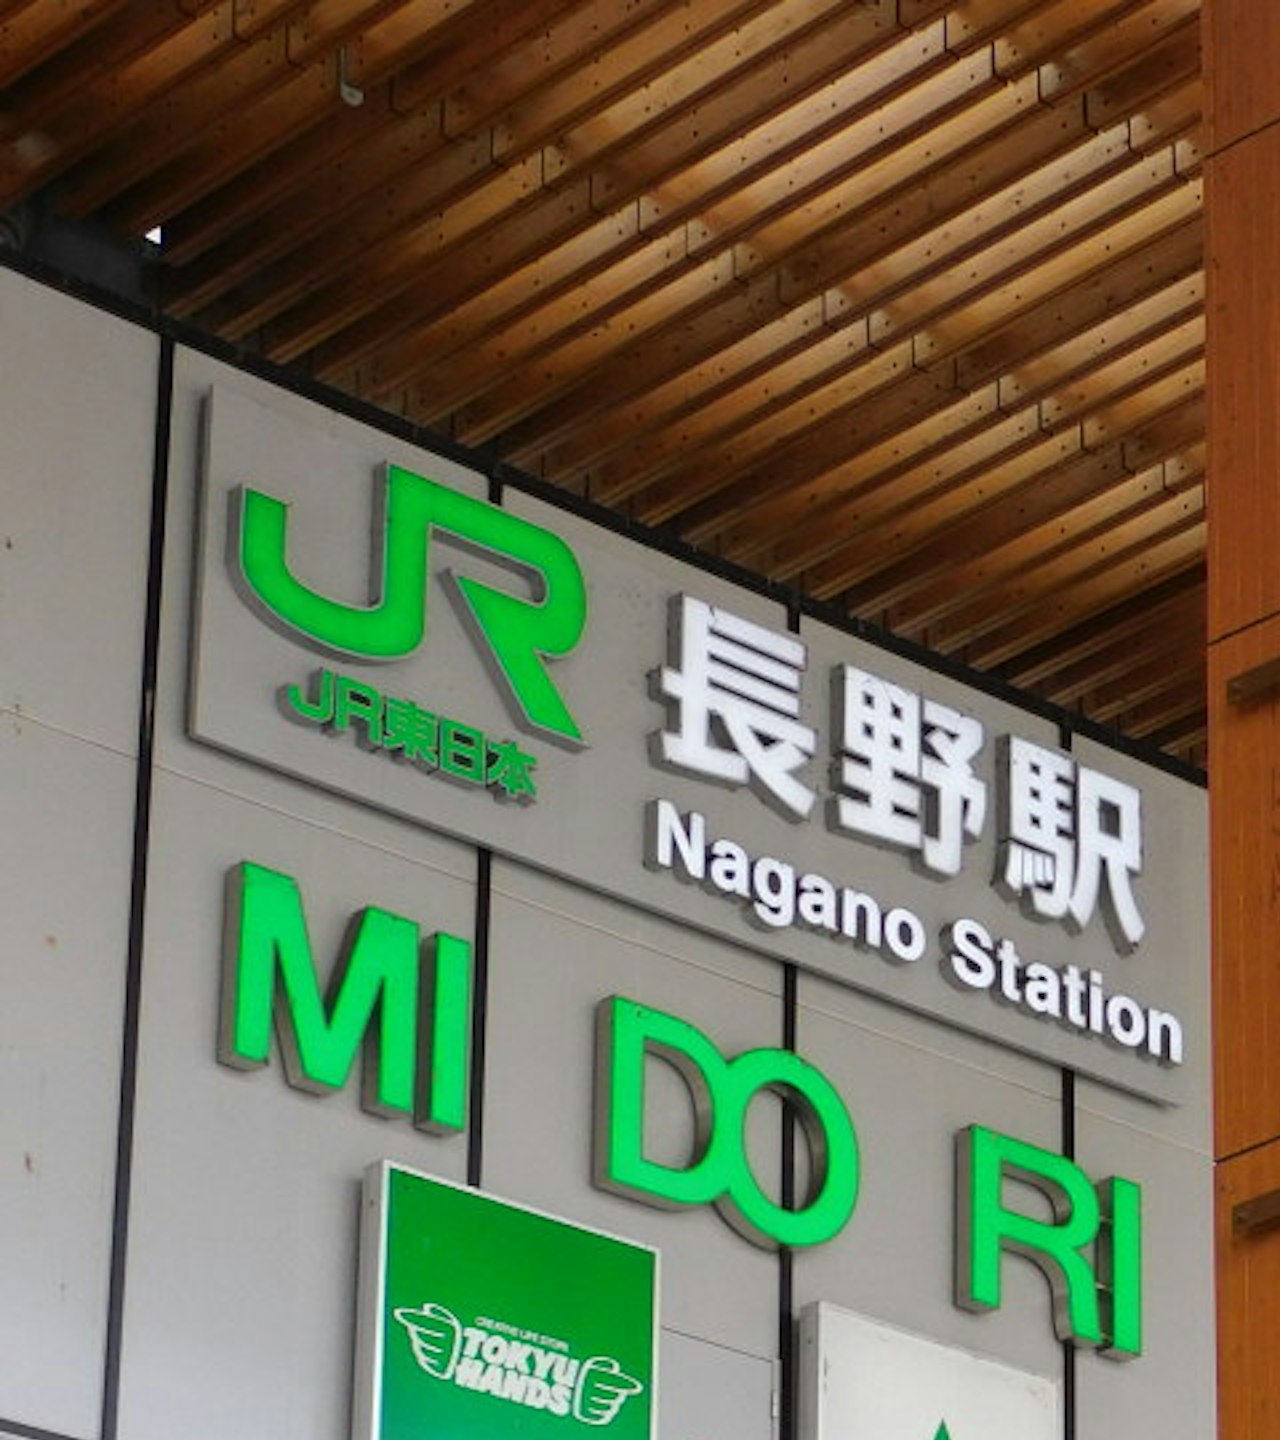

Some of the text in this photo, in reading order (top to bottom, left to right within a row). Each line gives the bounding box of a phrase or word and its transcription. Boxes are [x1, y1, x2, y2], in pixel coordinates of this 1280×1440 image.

[234, 462, 588, 748] JR
[279, 668, 539, 803] JR東日本
[653, 593, 1147, 954] 長野駅
[648, 799, 1183, 1065] Nagano Station
[454, 1357, 573, 1417] HANDS
[462, 1327, 580, 1388] TOKYU
